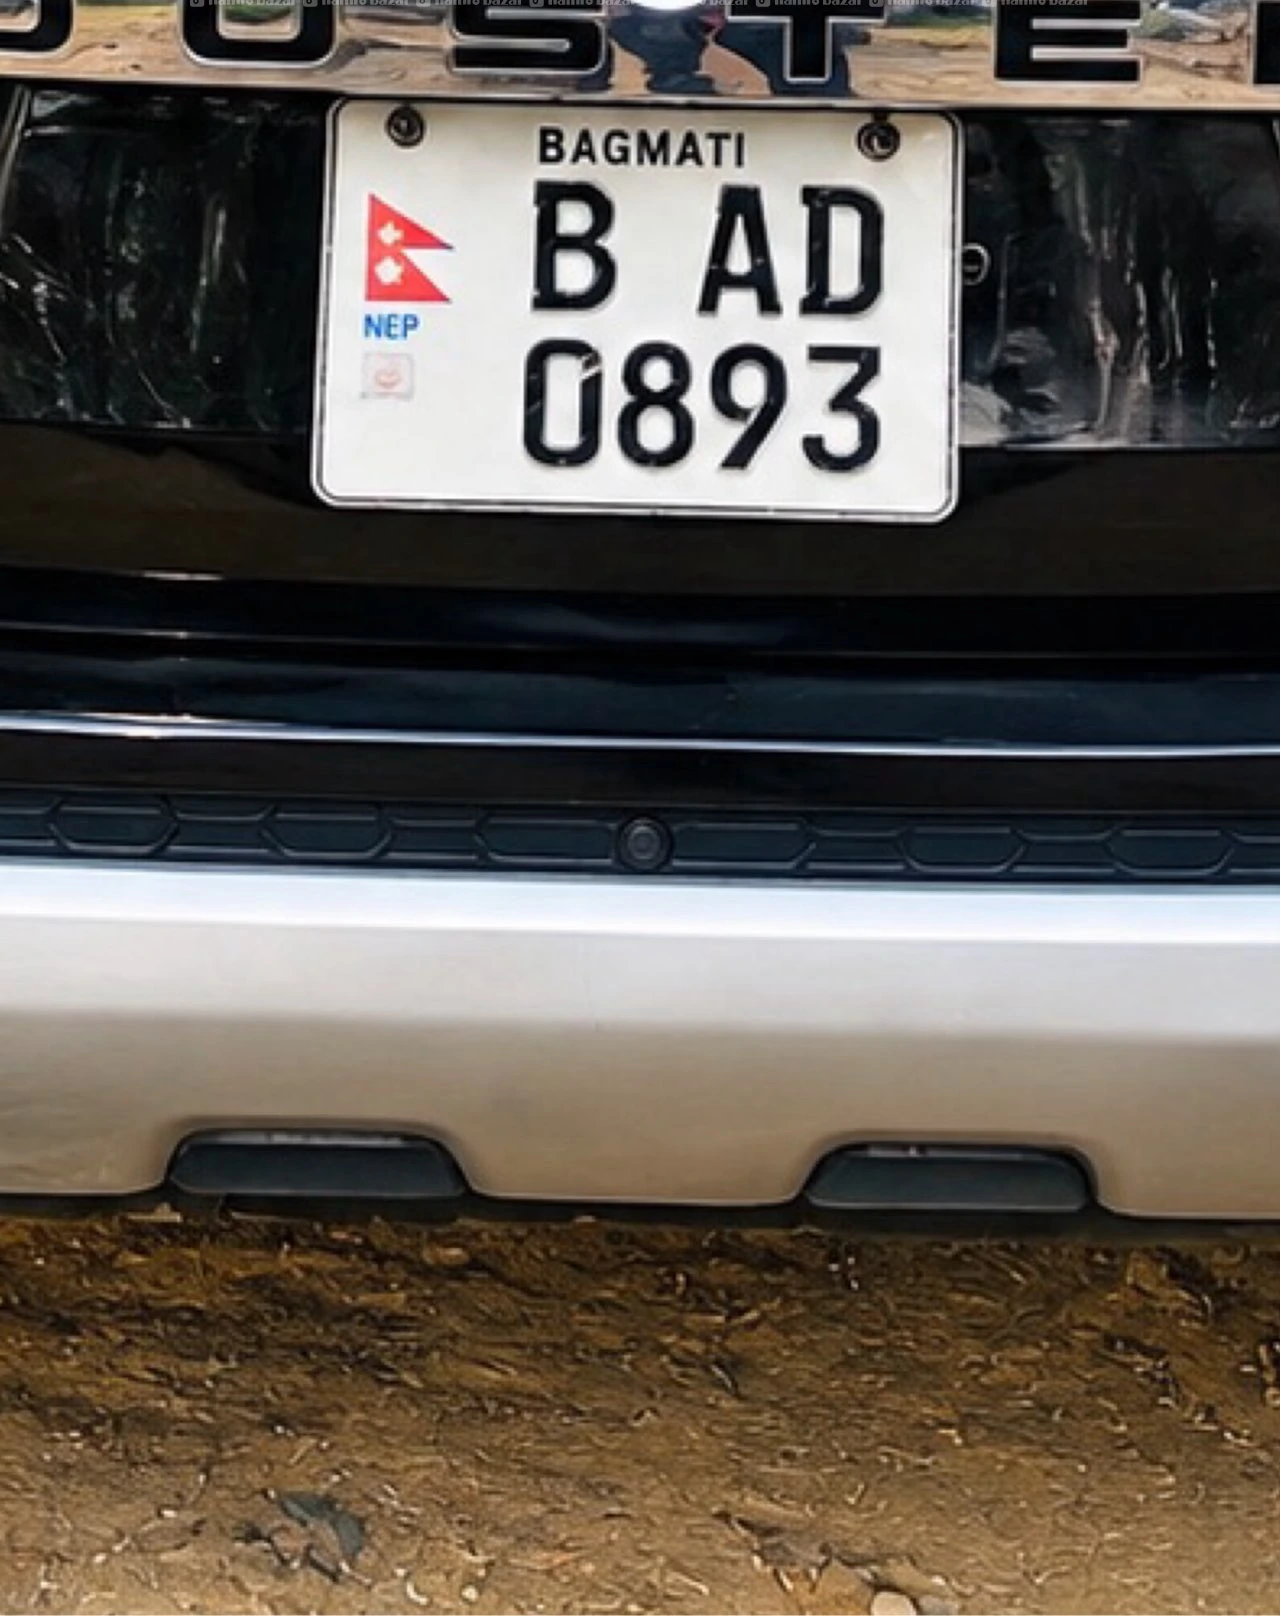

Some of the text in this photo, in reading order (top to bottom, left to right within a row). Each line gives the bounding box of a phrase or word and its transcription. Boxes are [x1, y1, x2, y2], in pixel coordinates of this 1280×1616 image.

[537, 126, 746, 169] BAGMATI
[531, 179, 887, 318] B AD
[363, 313, 421, 341] NEP
[522, 337, 883, 474] 0893
